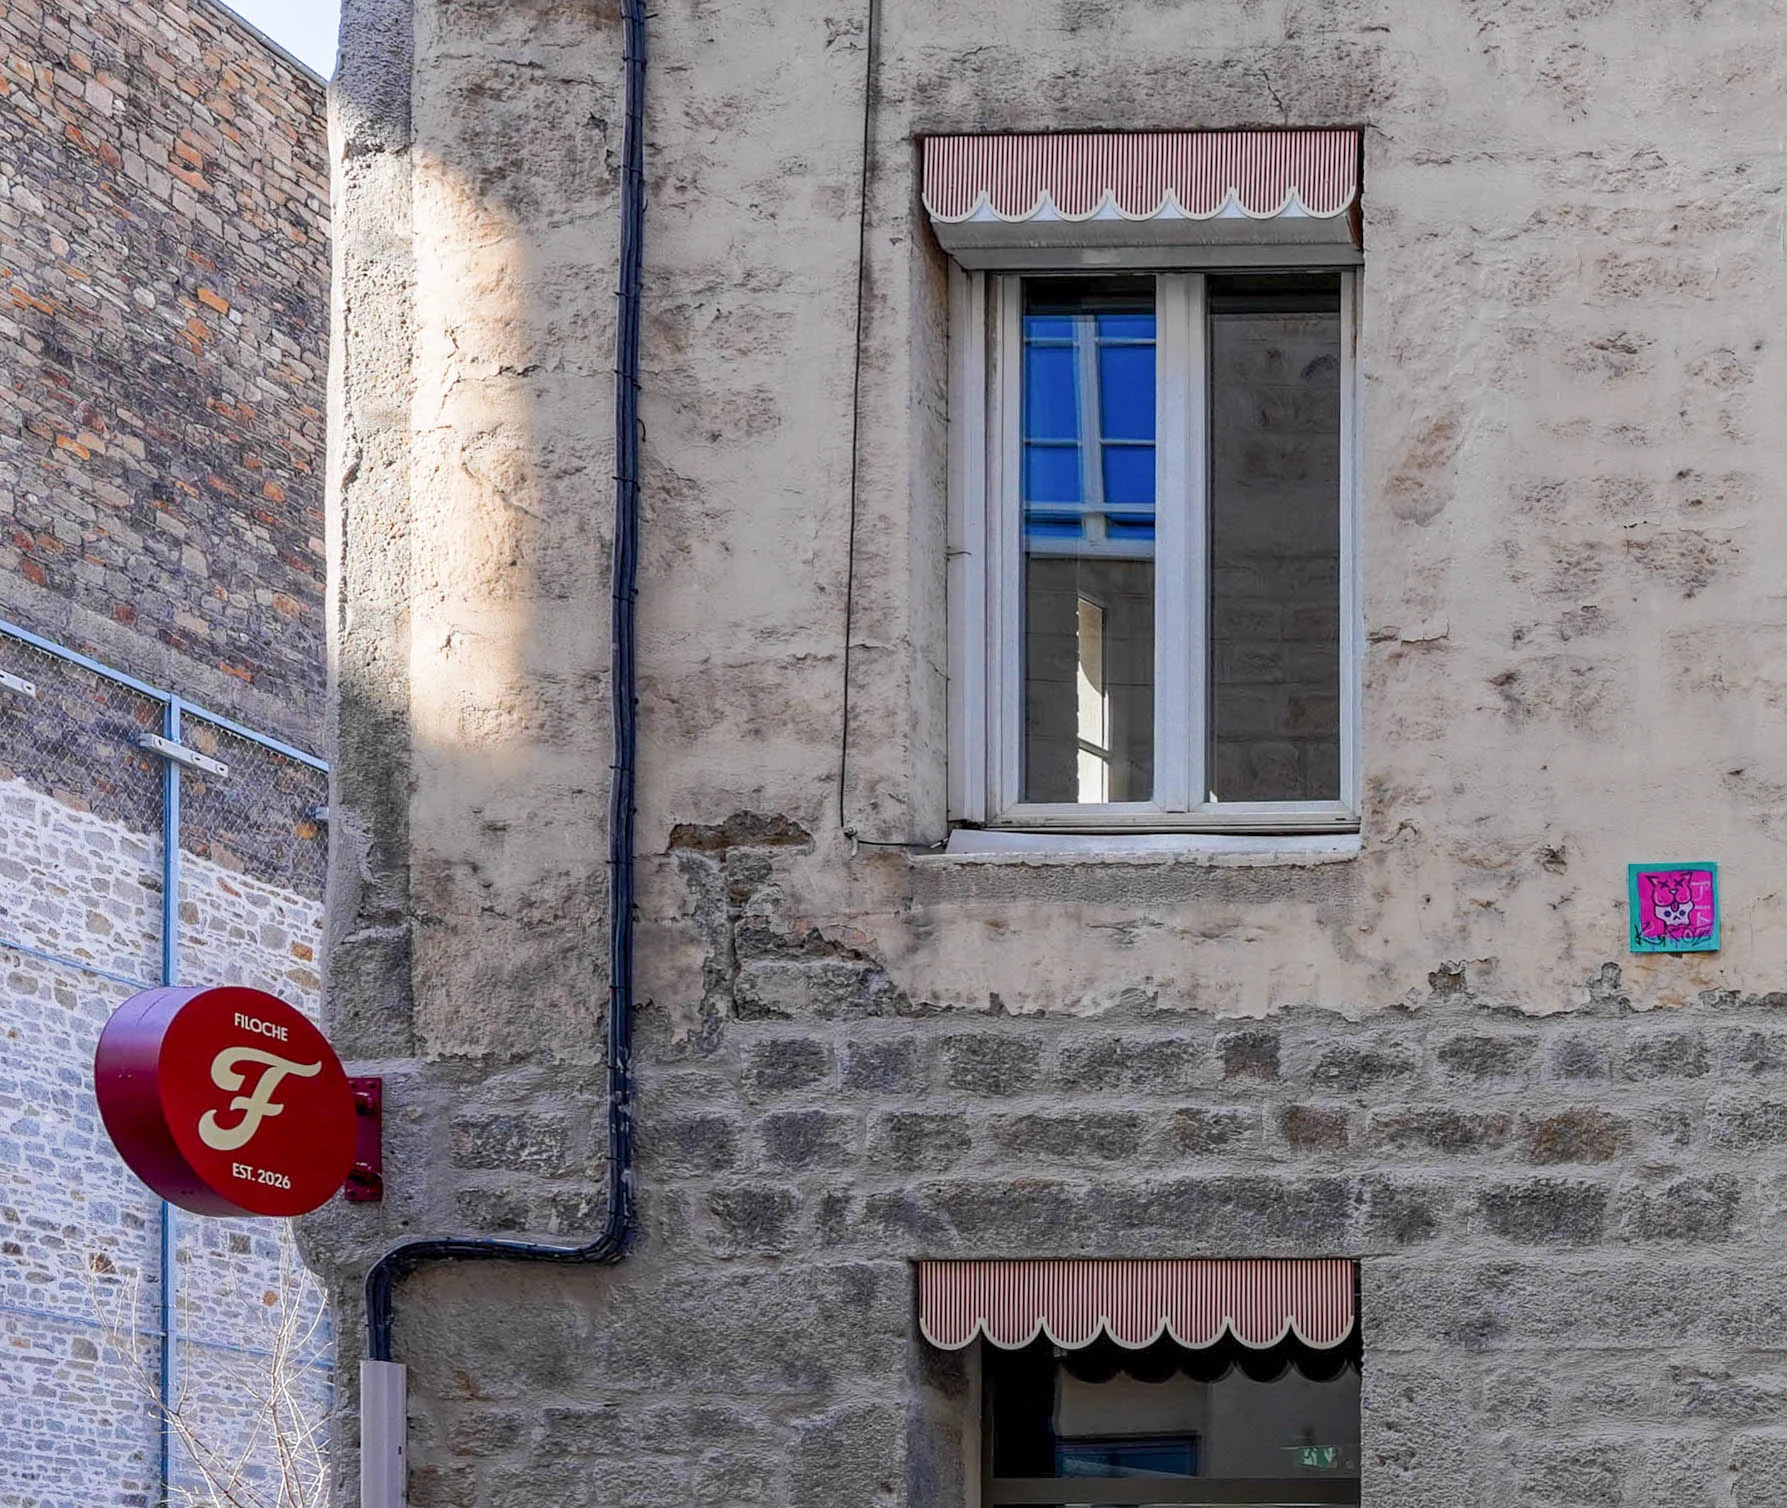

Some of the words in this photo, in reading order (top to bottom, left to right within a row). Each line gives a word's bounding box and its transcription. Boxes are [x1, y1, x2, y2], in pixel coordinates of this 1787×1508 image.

[234, 1012, 288, 1042] FILOCHE
[198, 1046, 322, 1151] F
[232, 1162, 256, 1182] EST.
[257, 1169, 291, 1190] 2026
